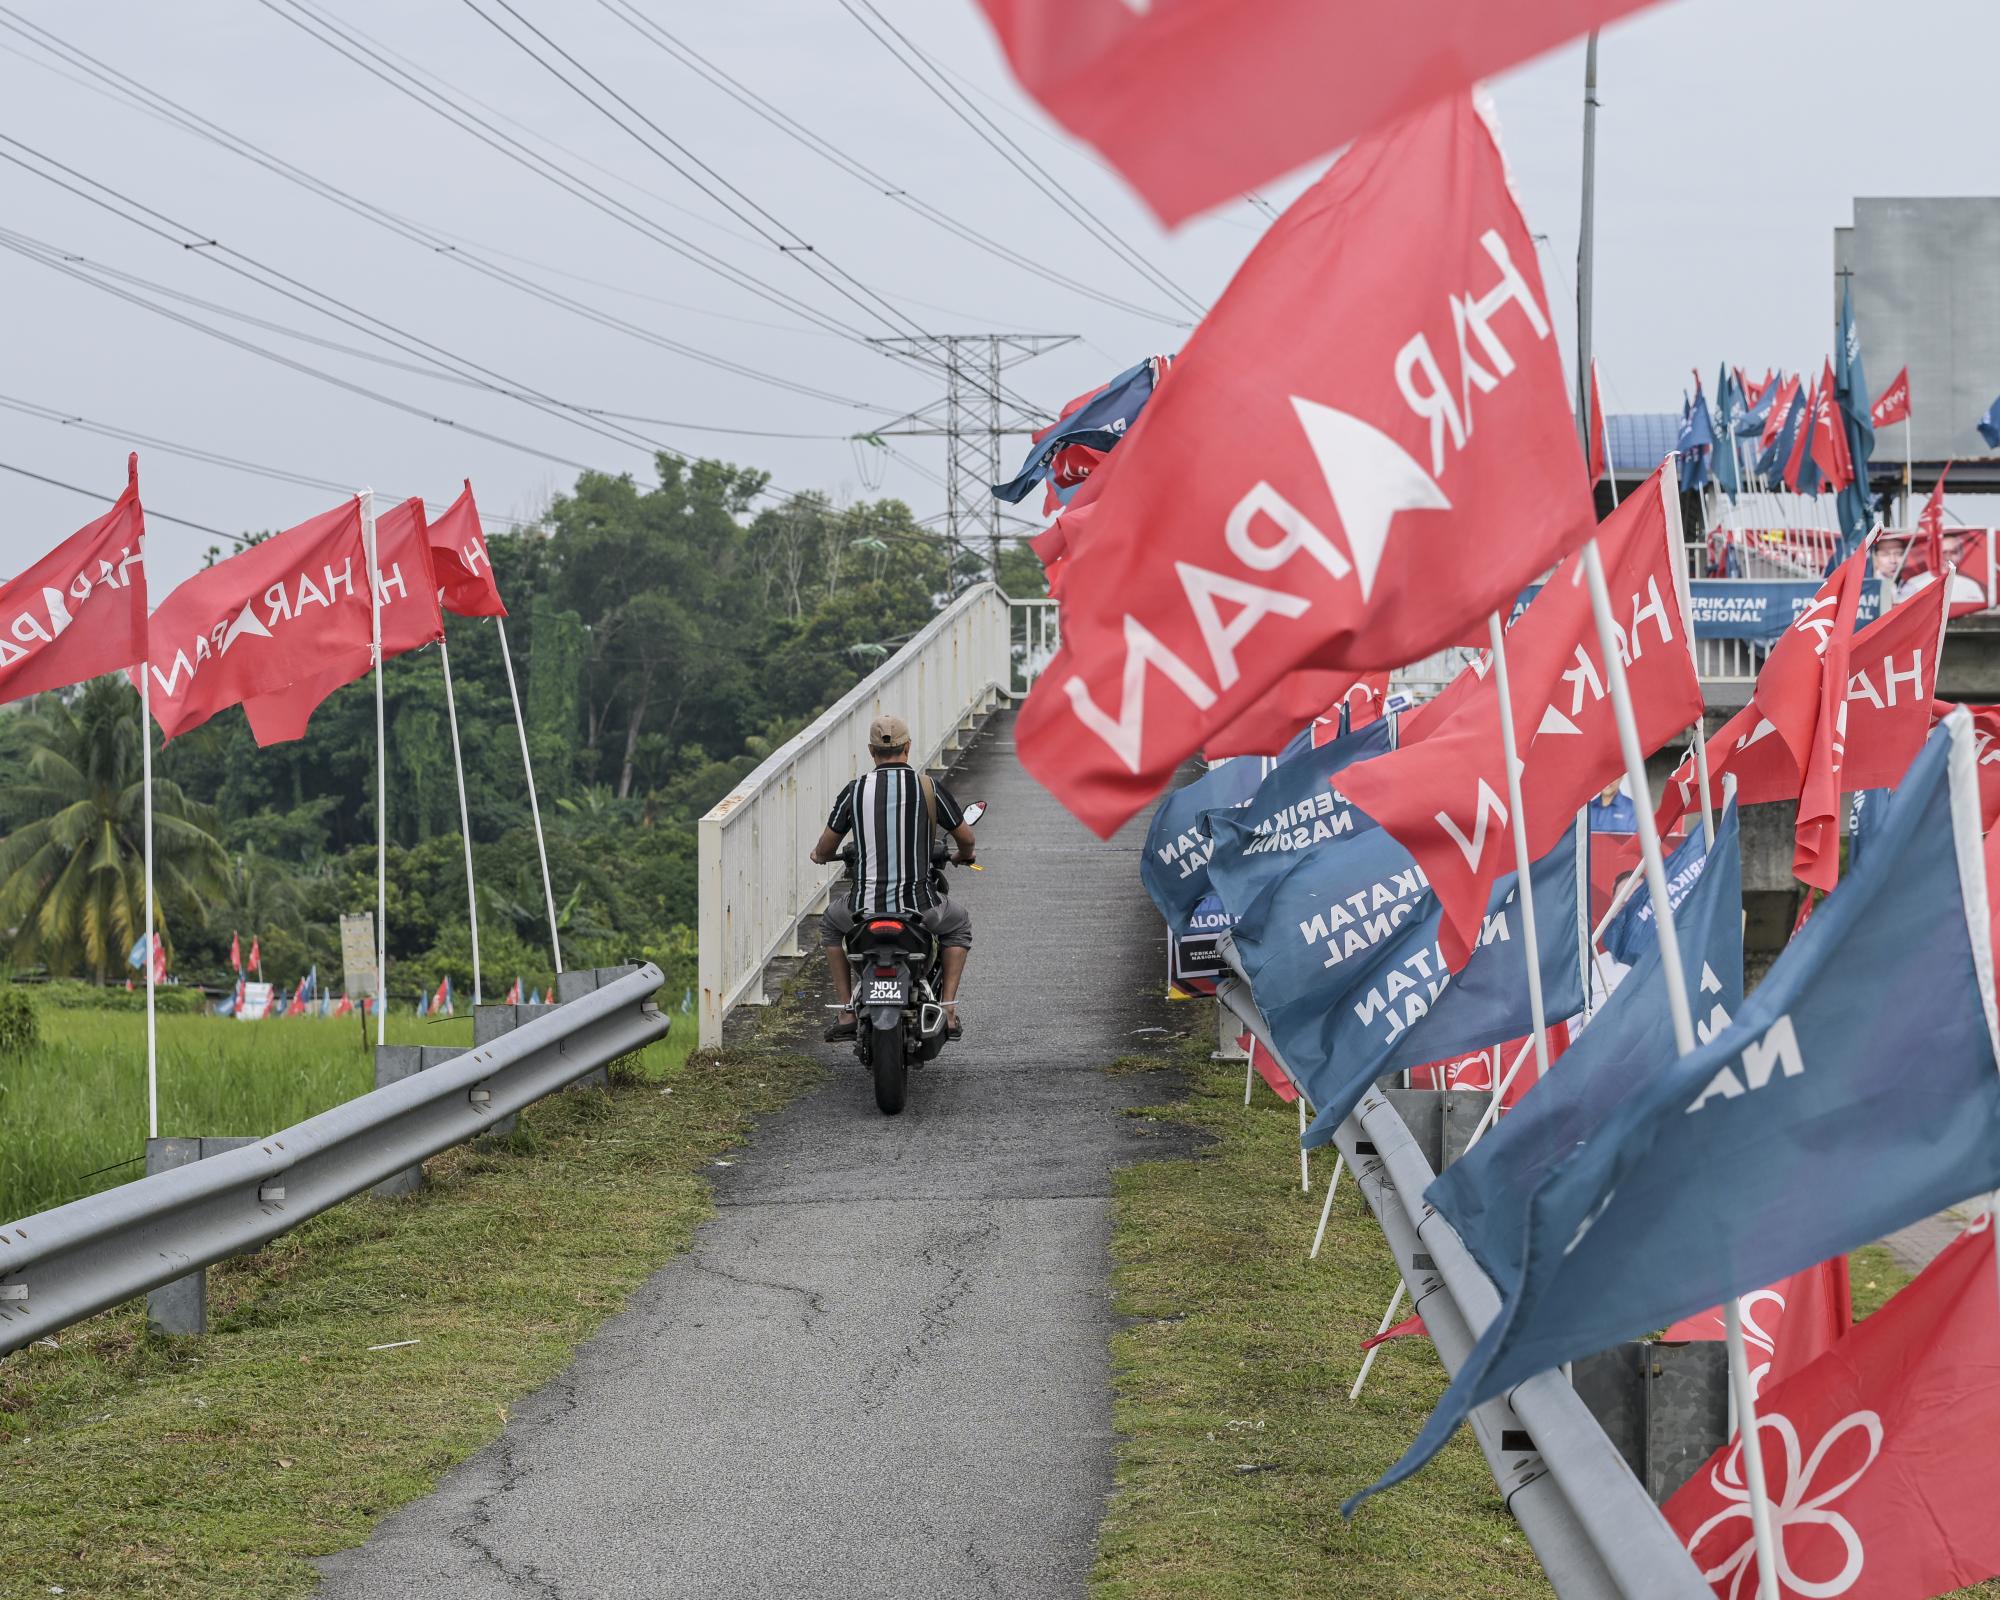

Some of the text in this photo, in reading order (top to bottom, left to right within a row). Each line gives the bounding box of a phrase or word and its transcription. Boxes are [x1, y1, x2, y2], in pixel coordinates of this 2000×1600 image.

[1689, 598, 1767, 610] ERIKATAN
[1691, 610, 1761, 623] ASIONAL
[1189, 913, 1231, 928] ALON
[874, 981, 898, 990] NDU
[869, 989, 902, 999] 2044
